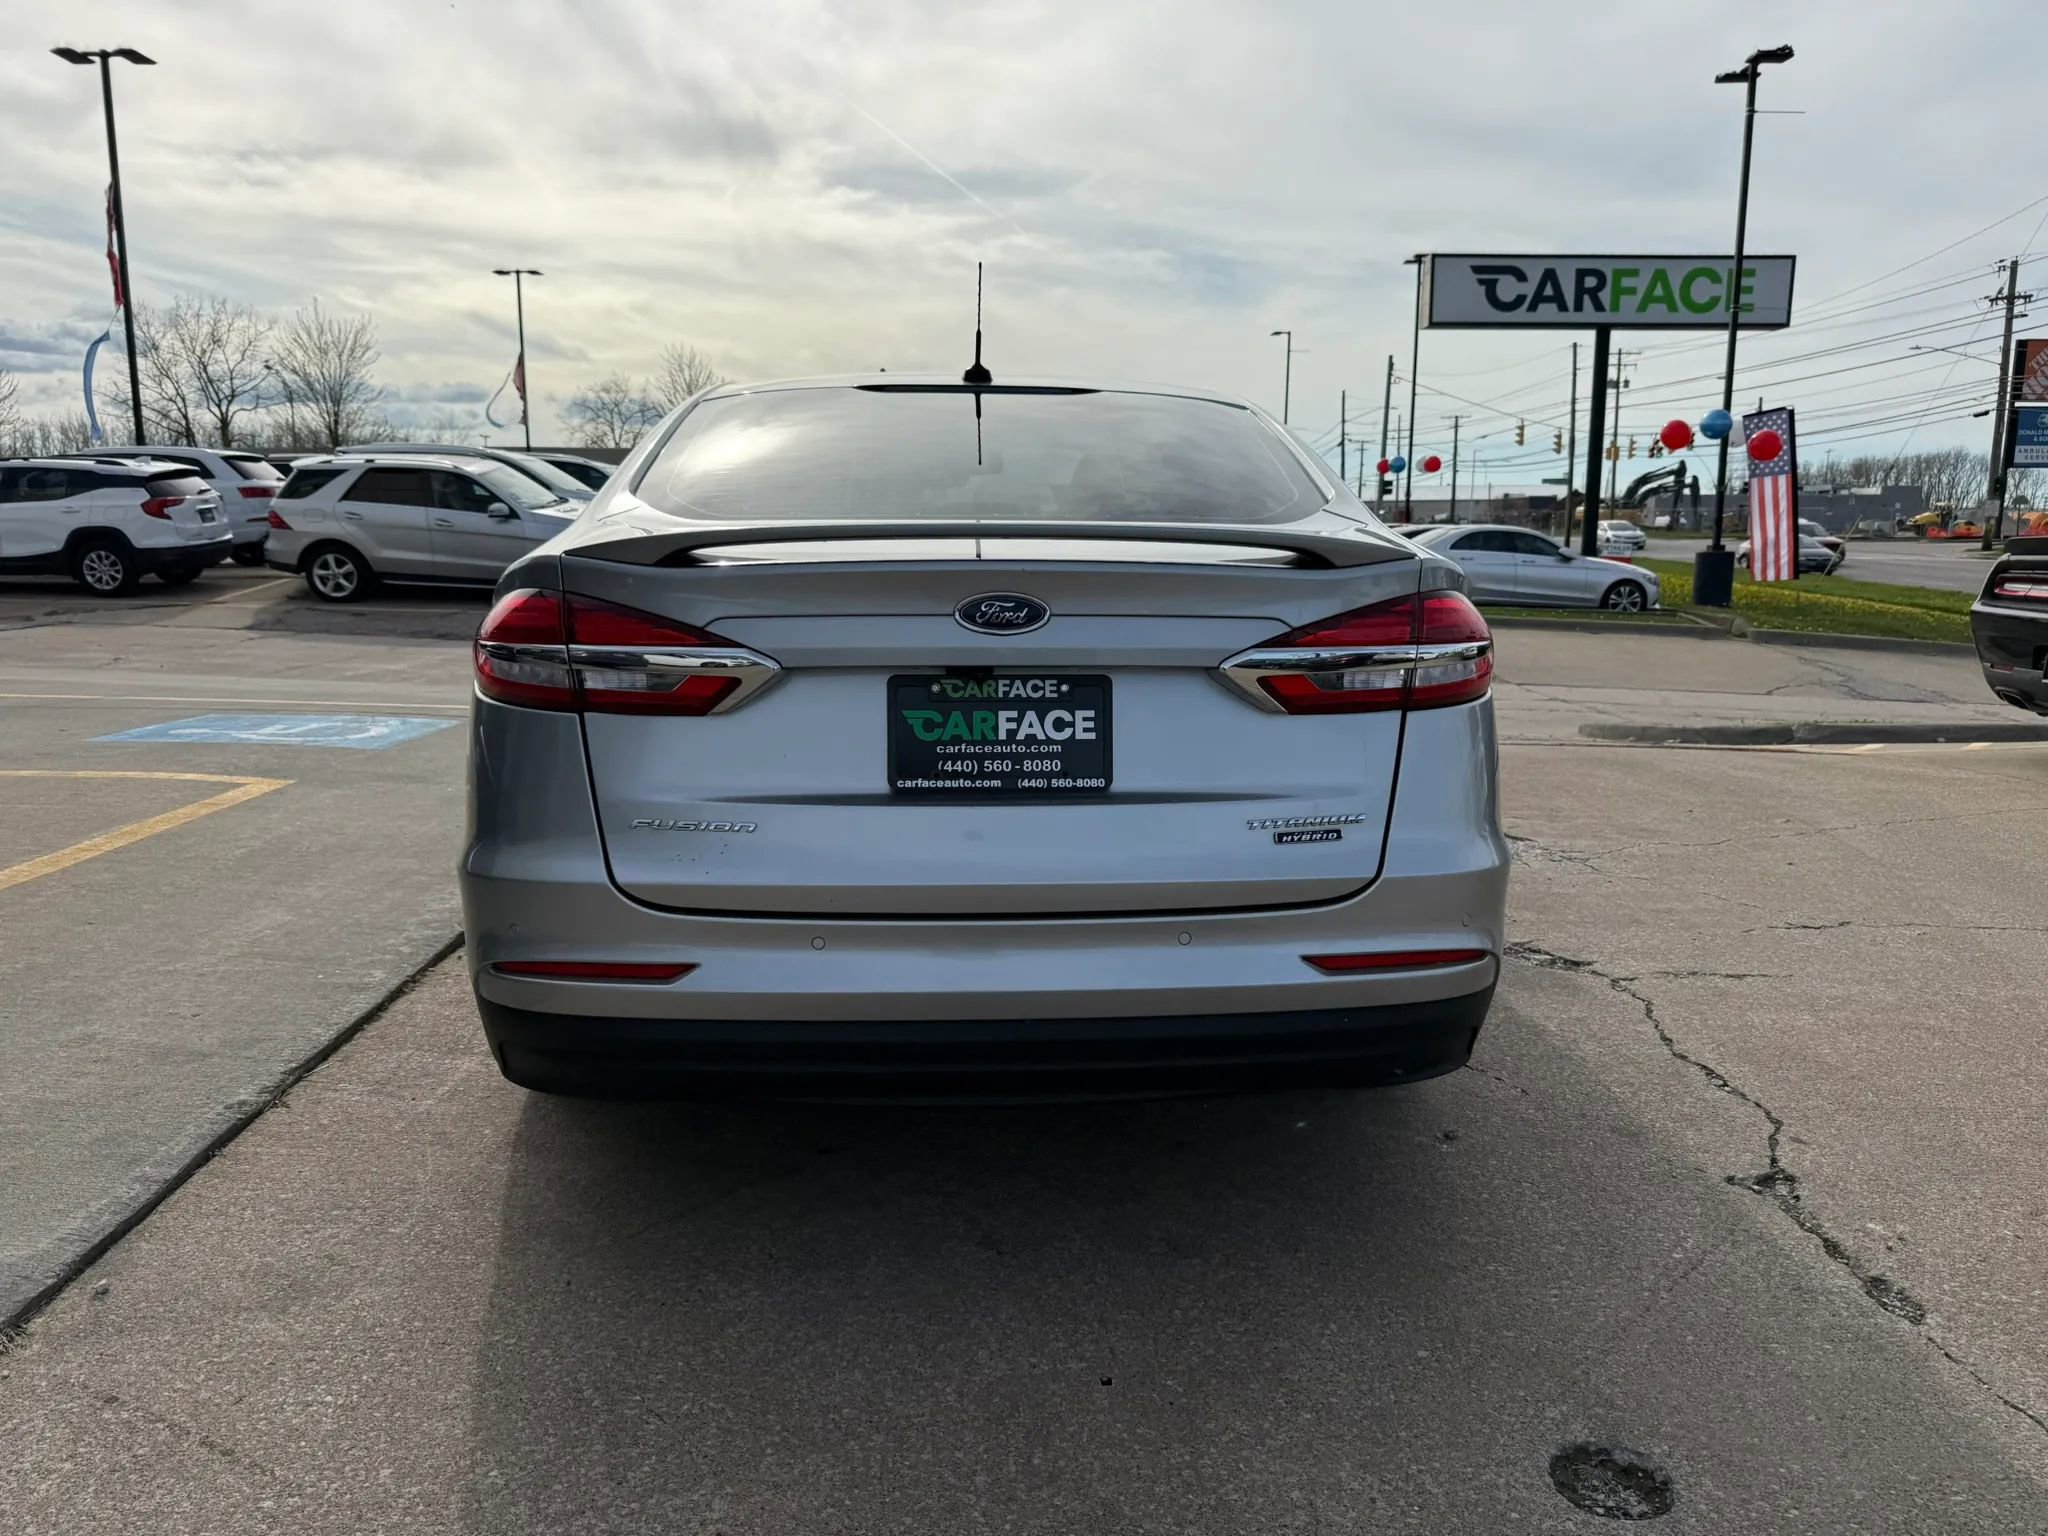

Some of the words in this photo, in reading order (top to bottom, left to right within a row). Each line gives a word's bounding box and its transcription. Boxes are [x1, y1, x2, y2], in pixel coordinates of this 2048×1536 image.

[1469, 264, 1757, 315] CARFACE
[975, 601, 1029, 624] Ford
[940, 679, 1058, 699] CARFACE
[902, 710, 1097, 741] CARFACE
[936, 743, 1062, 753] carfaceauto.com
[938, 760, 978, 775] (440)
[896, 778, 1001, 788] carfaceauto.com
[1017, 778, 1048, 789] (440)
[1051, 778, 1105, 788] 560-8080
[630, 819, 757, 833] FUSION
[1247, 813, 1367, 830] TITANIUM
[1282, 832, 1337, 842] HYBRID
